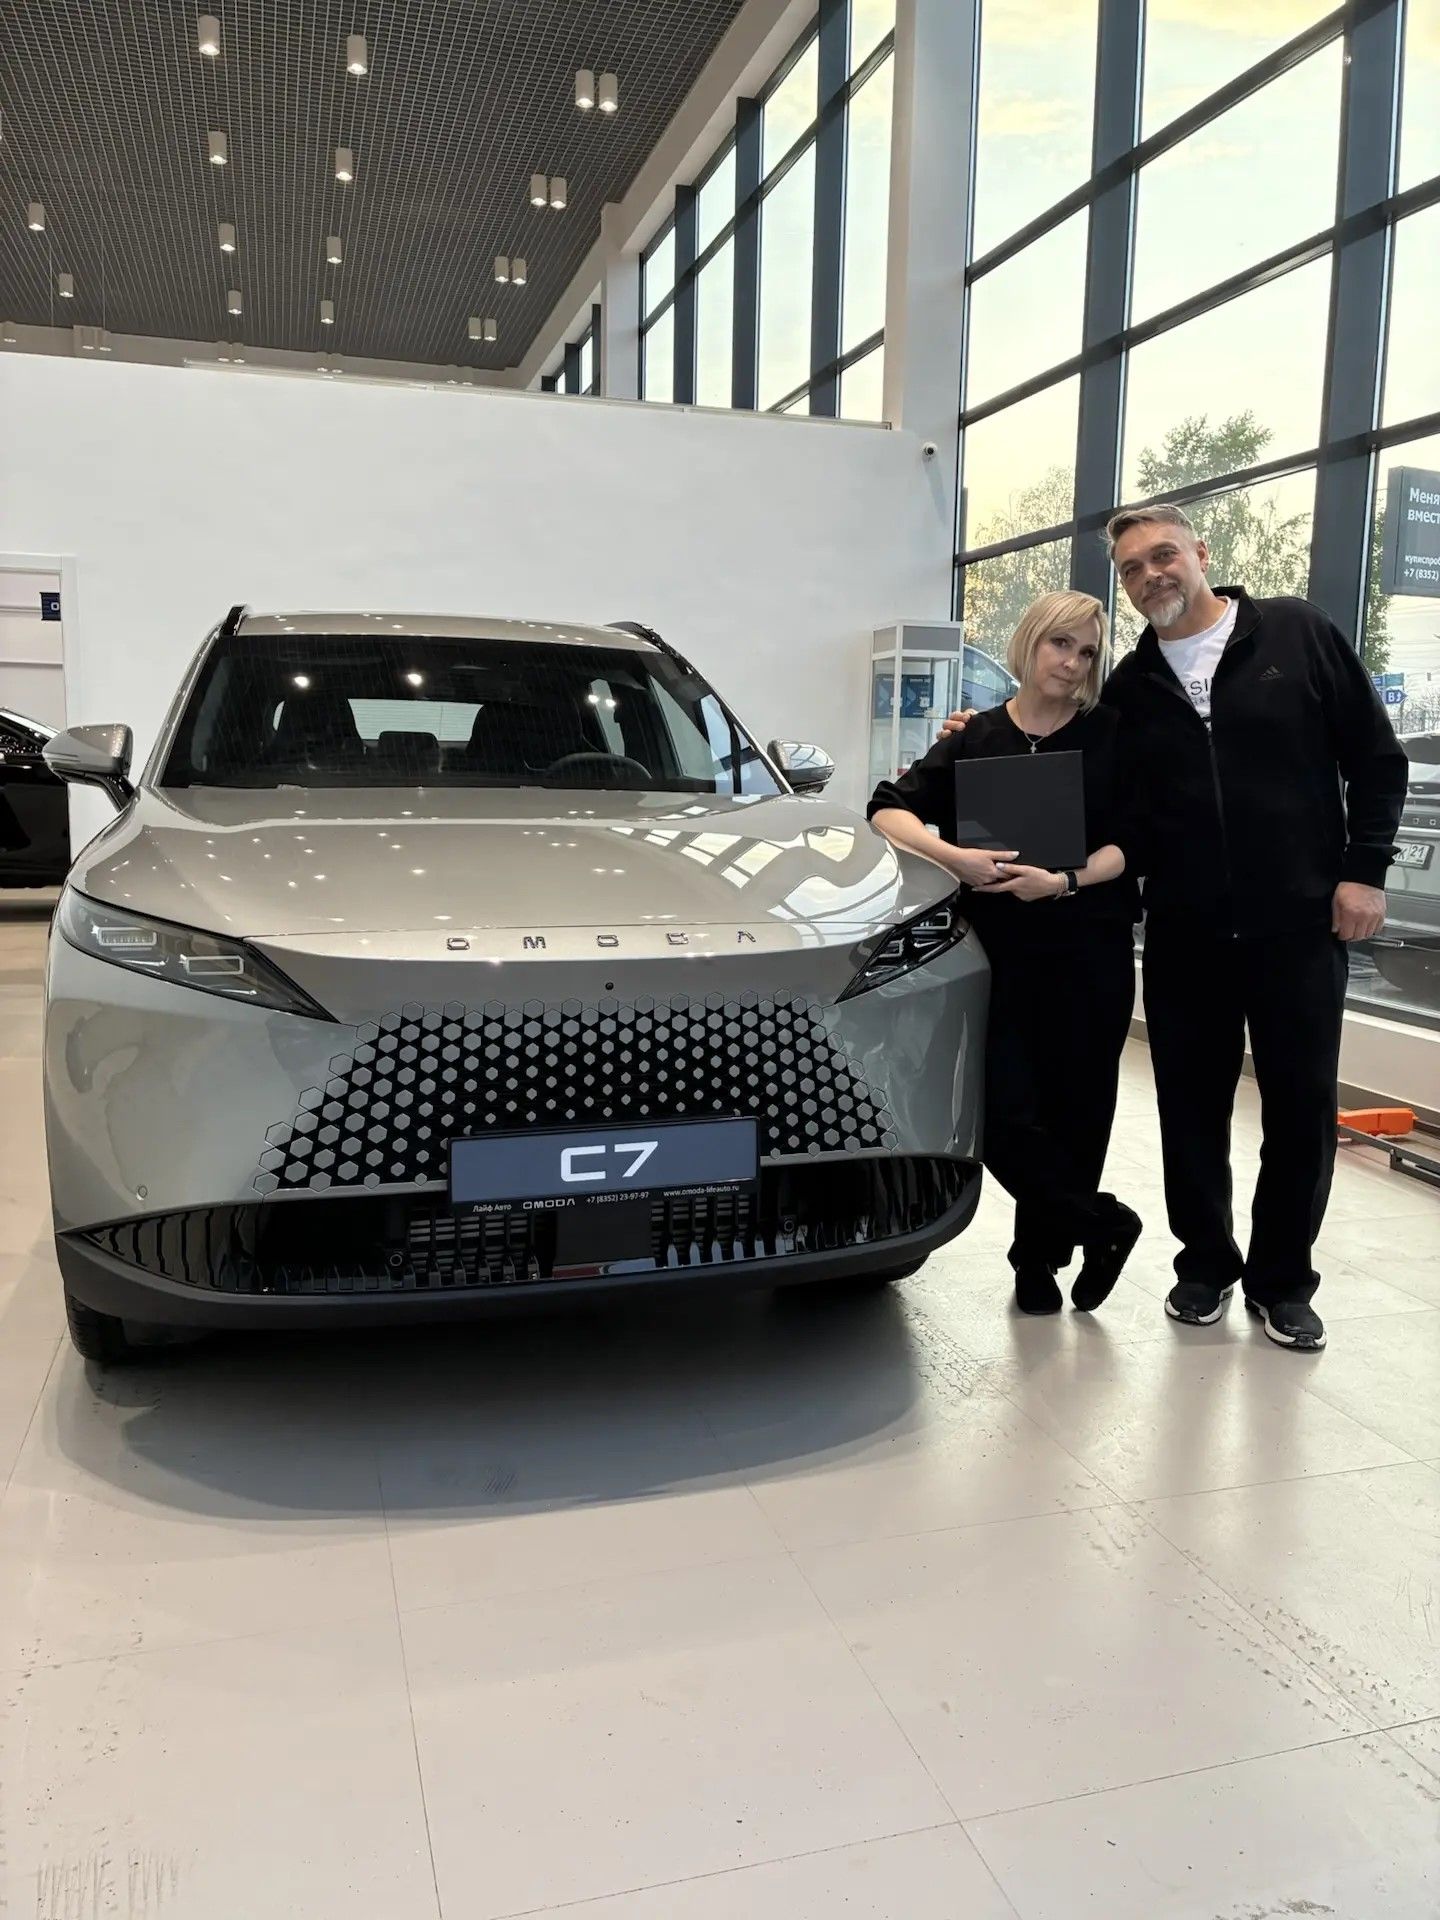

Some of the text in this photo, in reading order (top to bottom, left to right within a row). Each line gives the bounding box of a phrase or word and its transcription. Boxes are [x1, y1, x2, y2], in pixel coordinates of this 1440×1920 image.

[1404, 568, 1440, 581] +7 (8352)
[446, 931, 756, 951] OMODA
[560, 1141, 659, 1182] C7
[586, 1191, 649, 1204] +7 (8352) 23-97-97
[663, 1185, 740, 1198] www.omoda-lifeauto.ru
[472, 1203, 513, 1214] Лайф Авто
[522, 1198, 576, 1210] OMODA
